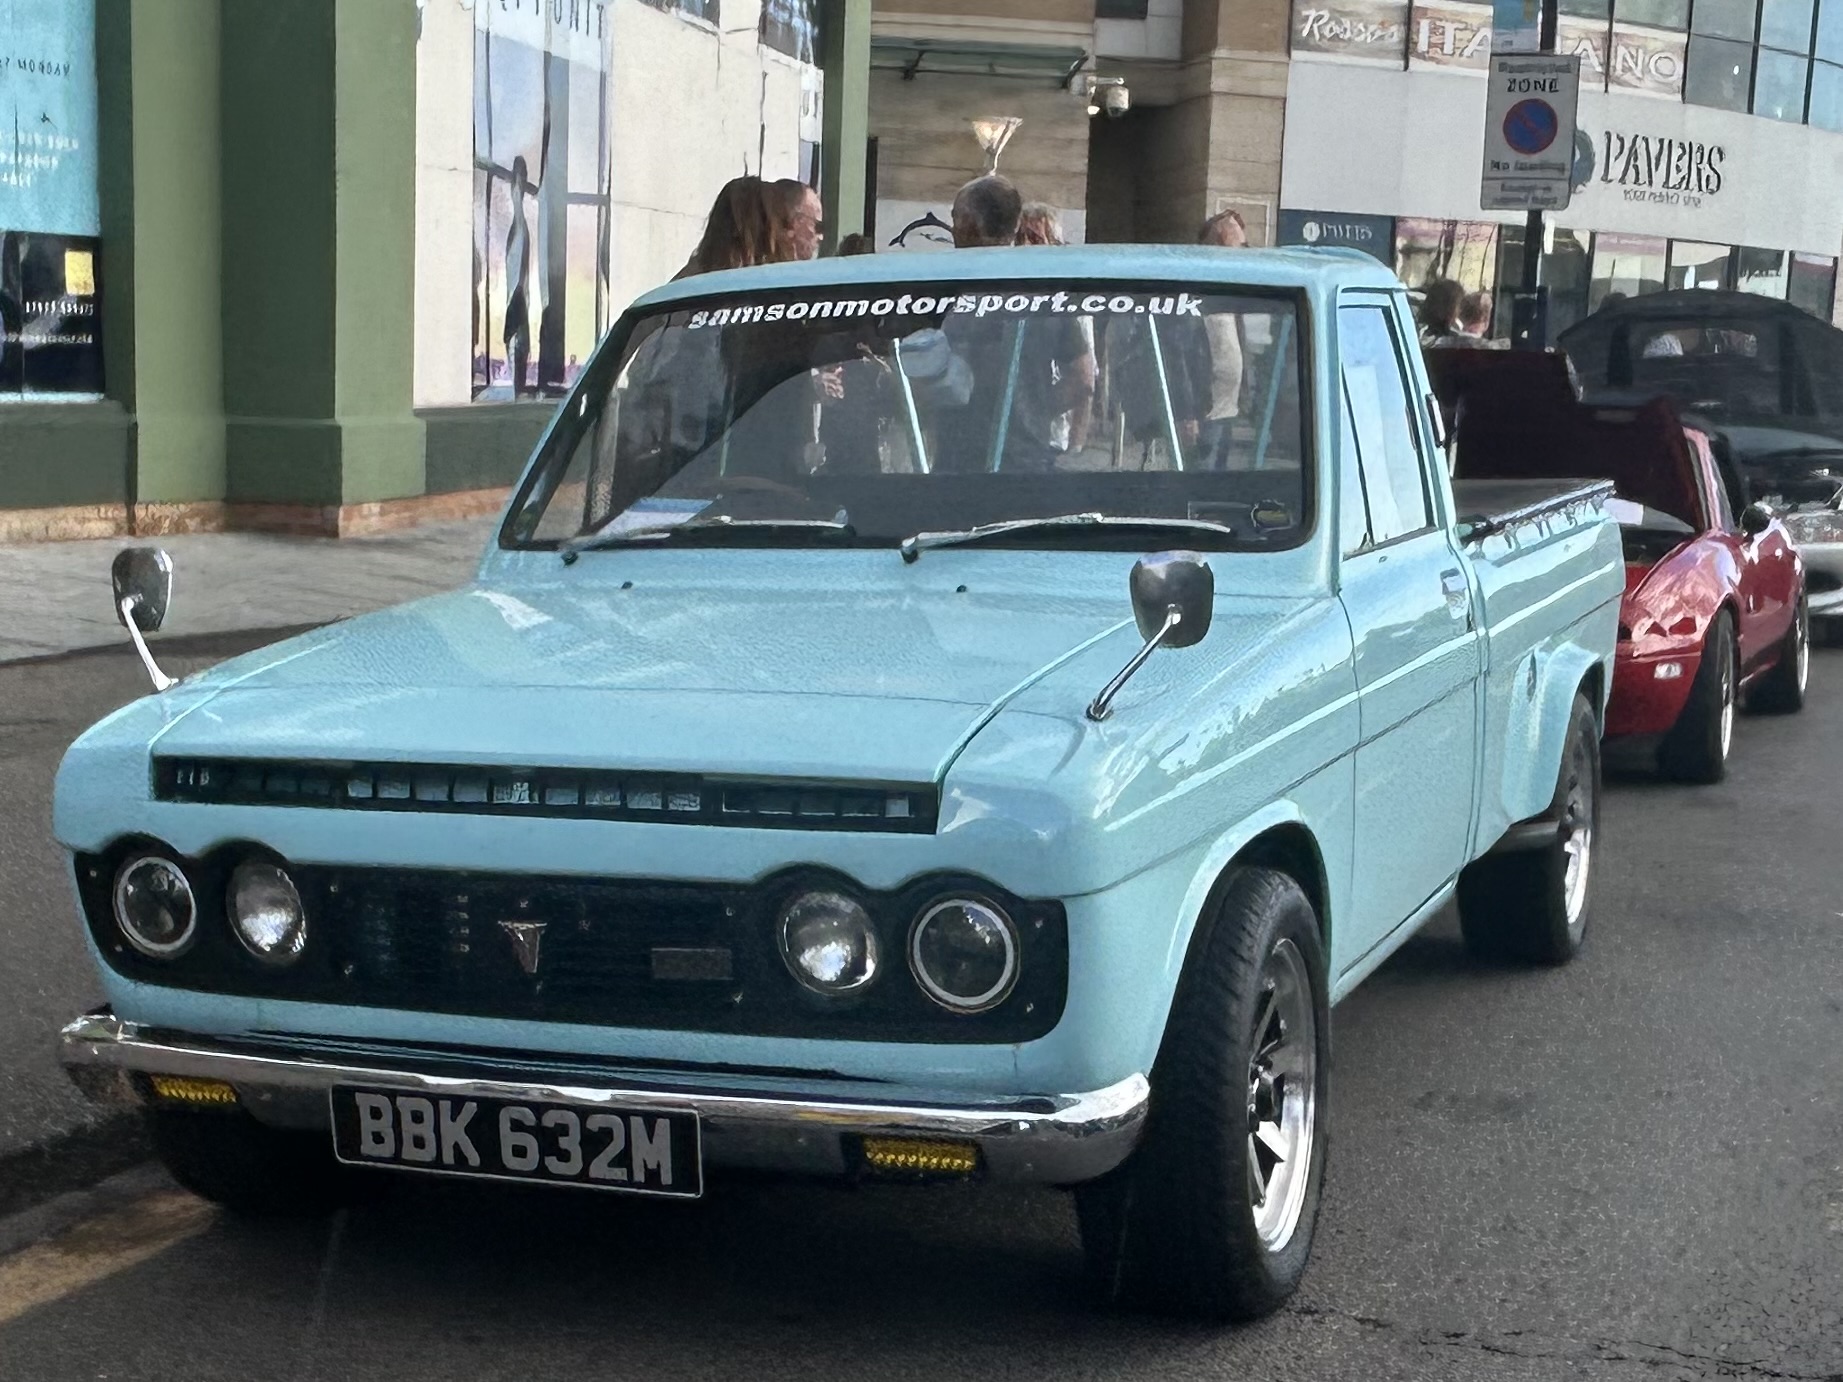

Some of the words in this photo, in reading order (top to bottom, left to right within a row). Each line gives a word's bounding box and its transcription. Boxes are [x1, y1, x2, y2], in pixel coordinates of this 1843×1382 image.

[1416, 18, 1681, 82] ITAANO
[1506, 77, 1560, 94] ZONE
[1600, 130, 1726, 195] PAVERS
[688, 291, 1203, 330] samsonmotorsport.co.uk
[354, 1091, 481, 1167] BBK
[499, 1105, 673, 1187] 632M
